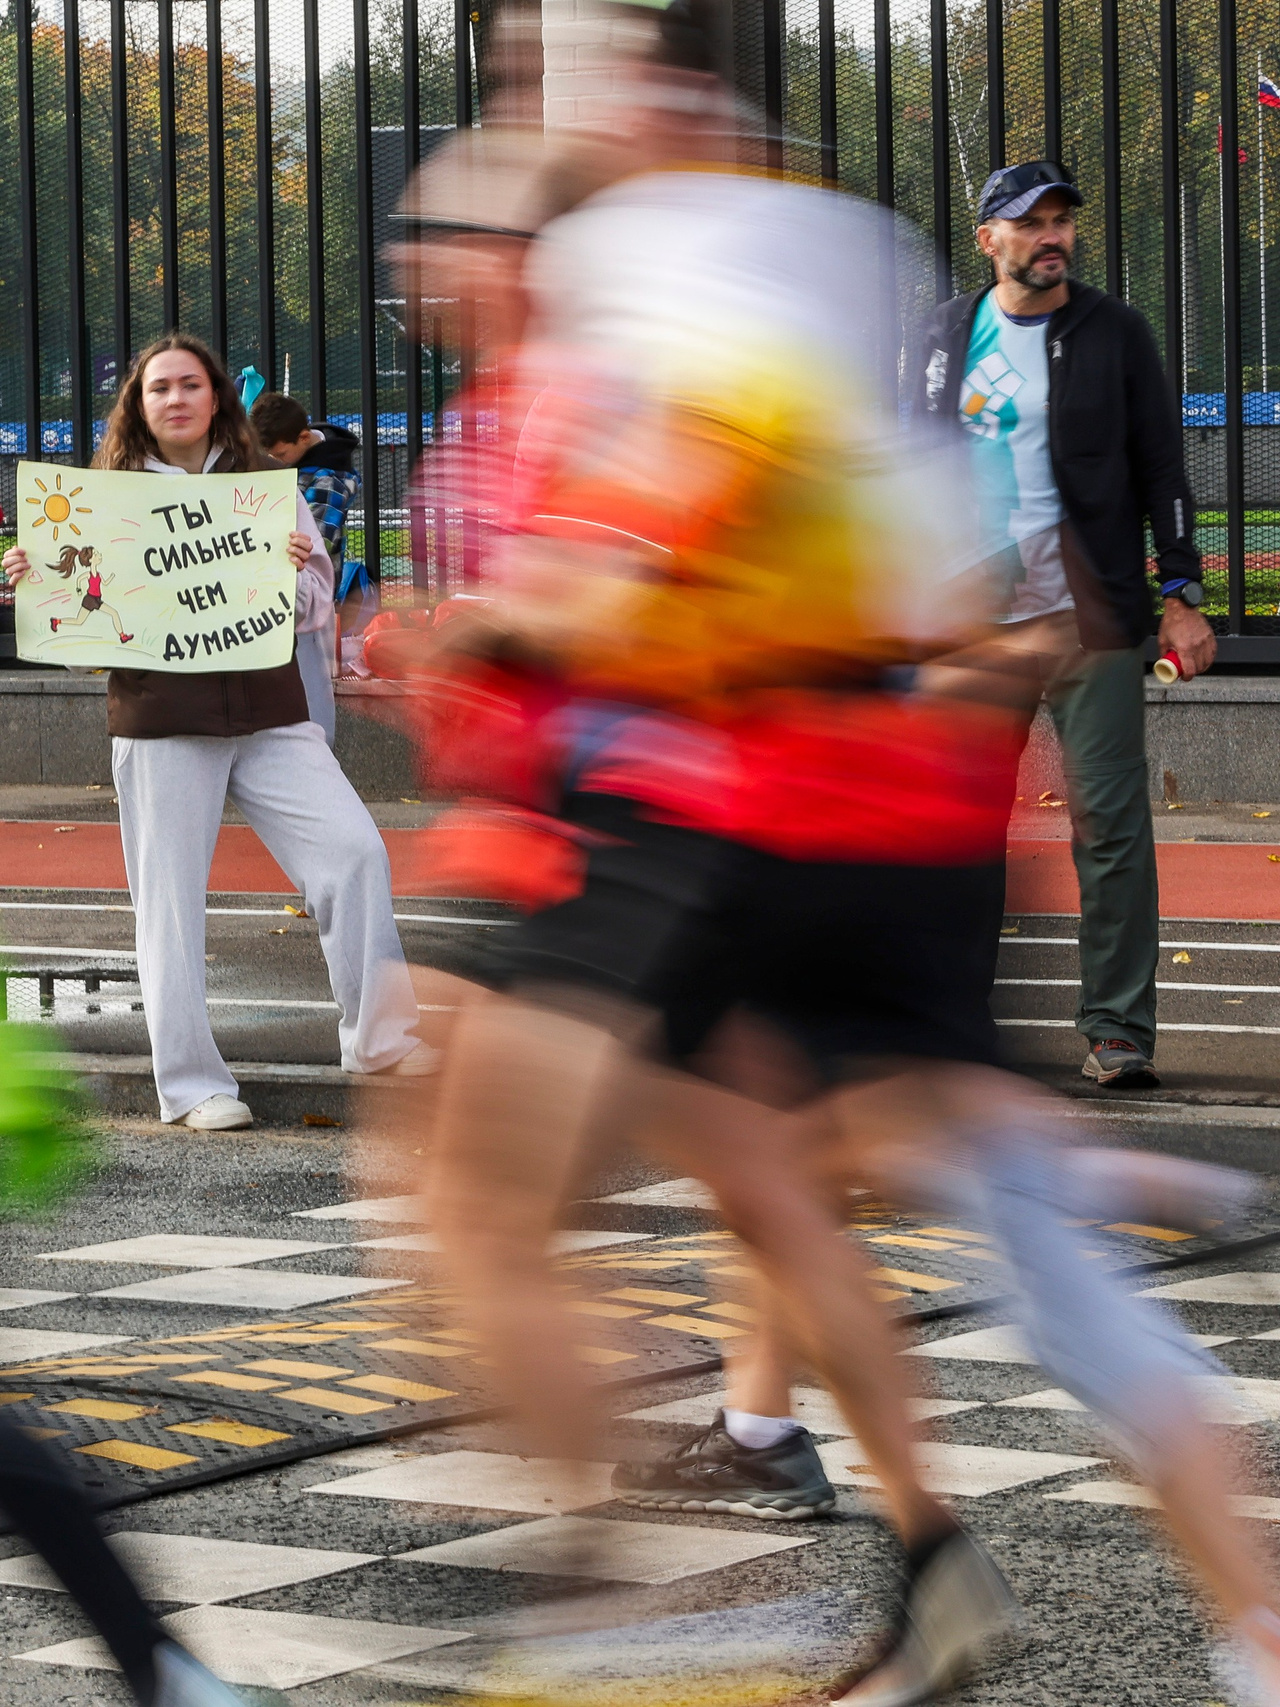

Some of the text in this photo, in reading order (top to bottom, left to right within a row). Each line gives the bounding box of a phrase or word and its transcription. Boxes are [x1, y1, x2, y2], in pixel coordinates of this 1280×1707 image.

[151, 499, 213, 533] ТЫ
[145, 528, 271, 576] СИЛЬНЕЕ,
[178, 581, 227, 614] ЧЕМ
[163, 591, 293, 661] ДУМАЕШЬ!
